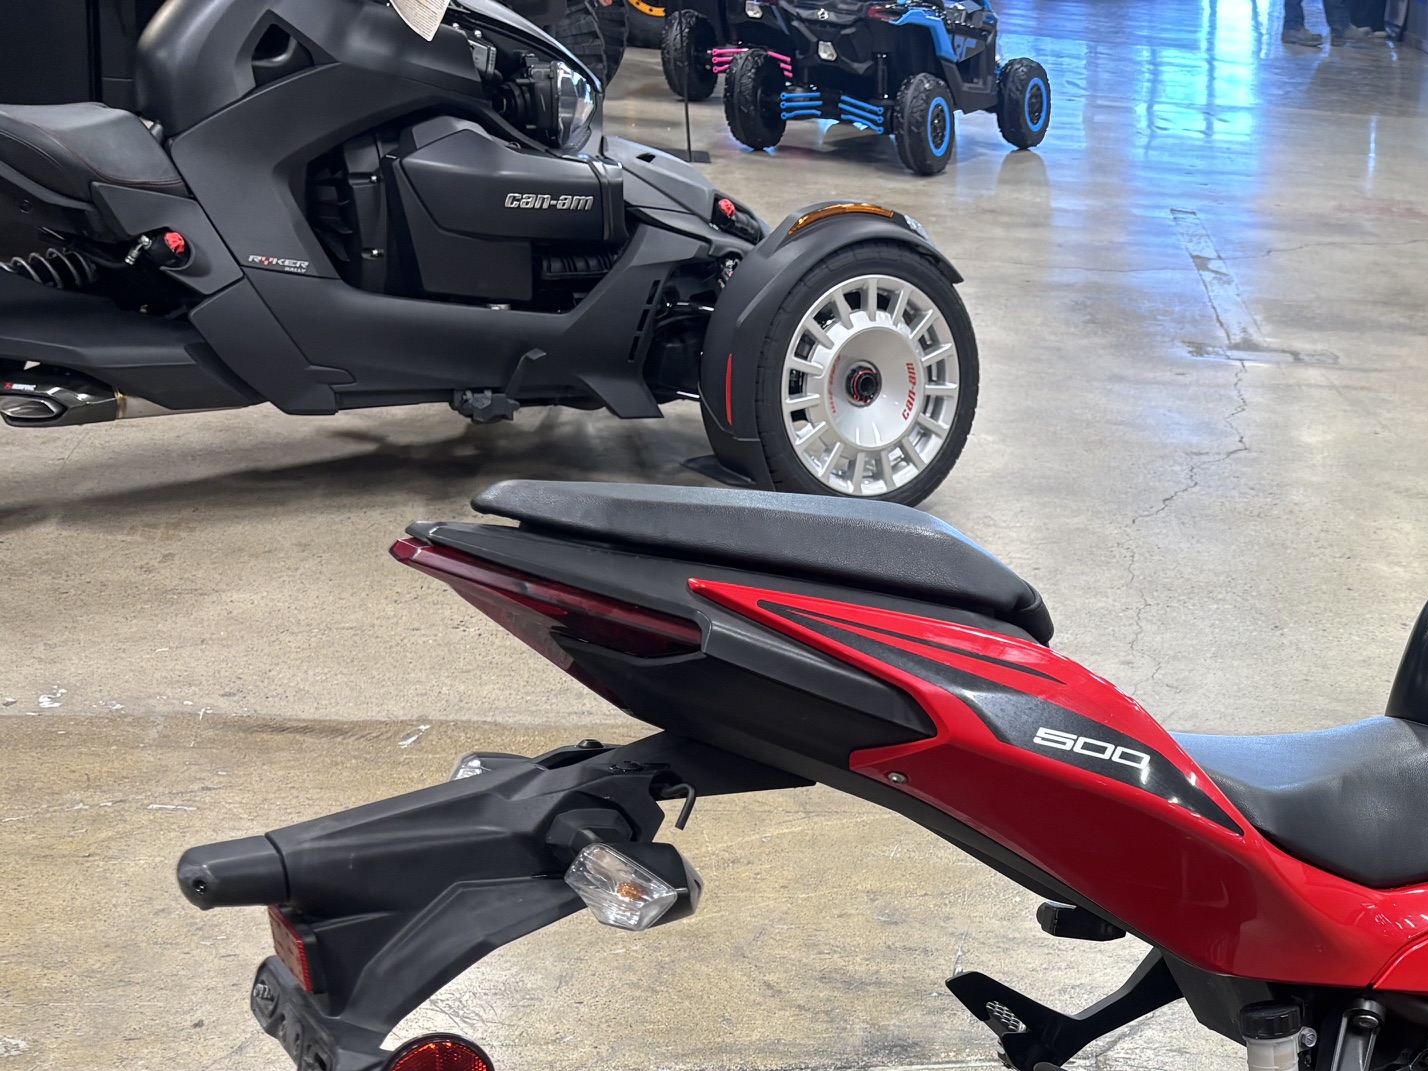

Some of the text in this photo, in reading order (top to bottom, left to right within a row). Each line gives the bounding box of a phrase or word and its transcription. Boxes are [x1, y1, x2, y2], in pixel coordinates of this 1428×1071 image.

[504, 192, 595, 212] can-am
[248, 254, 310, 269] RYKER
[901, 362, 918, 421] can-am
[1033, 726, 1151, 769] 500
